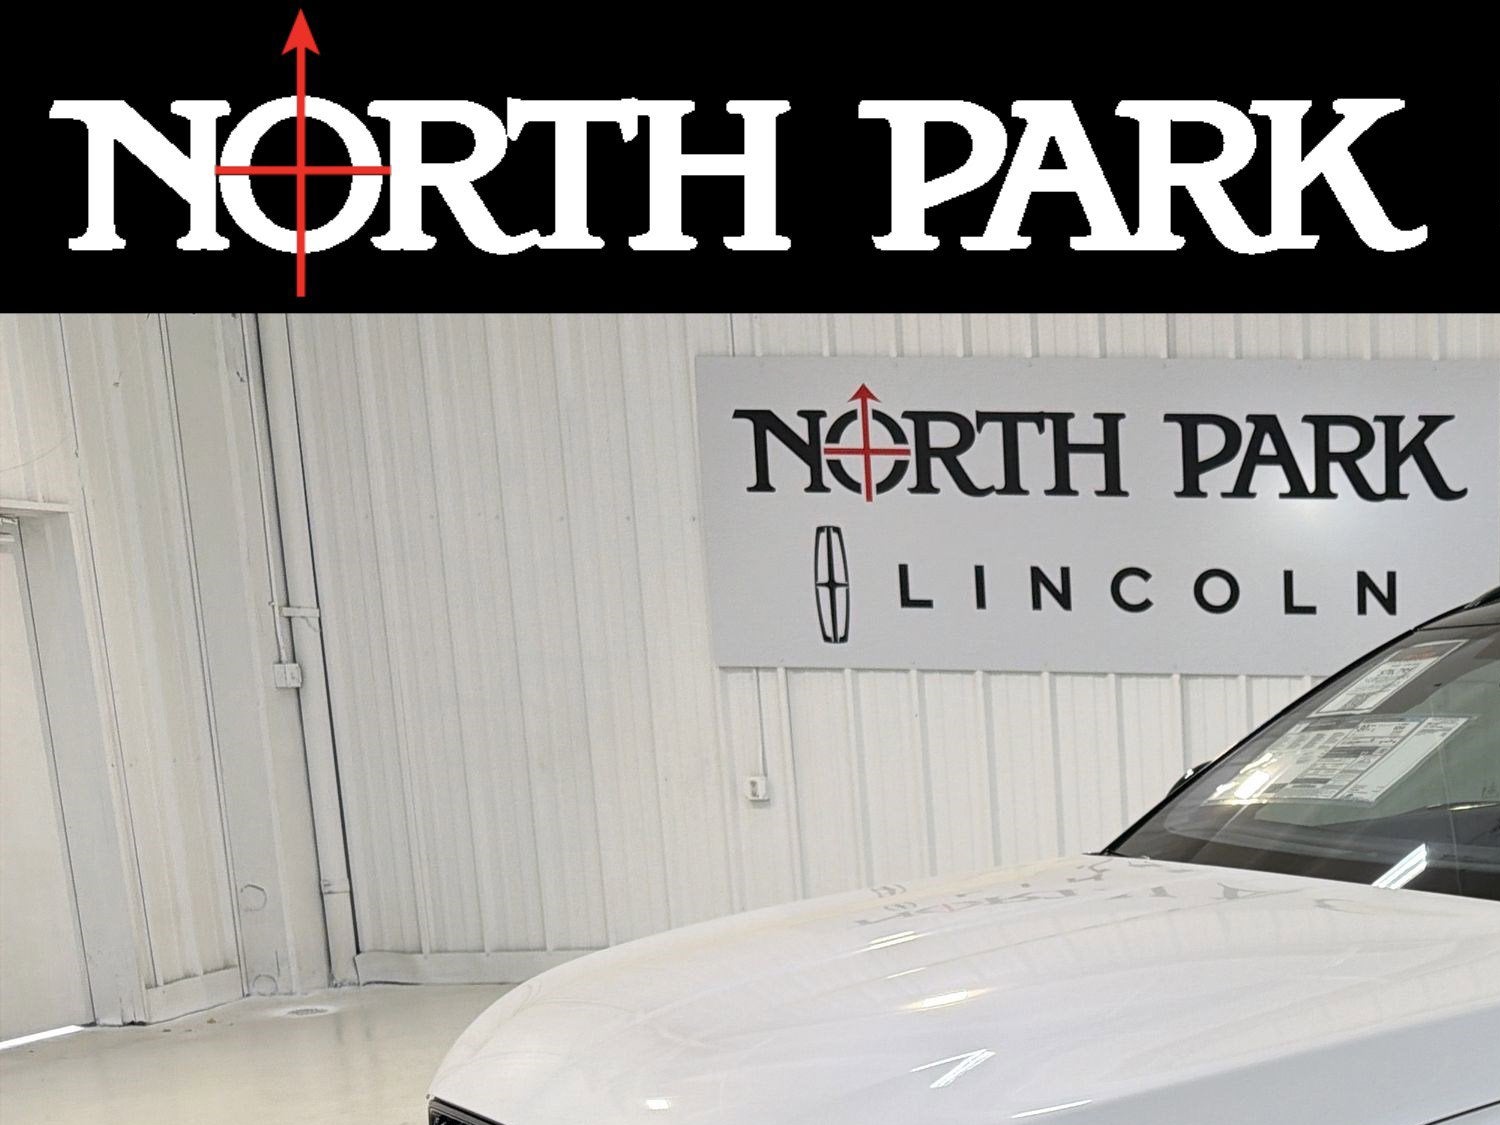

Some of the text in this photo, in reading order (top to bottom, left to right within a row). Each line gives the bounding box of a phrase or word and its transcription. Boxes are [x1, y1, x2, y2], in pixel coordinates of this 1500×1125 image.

[733, 409, 1468, 502] NORTH PARK
[898, 563, 1397, 616] LINCOLN
